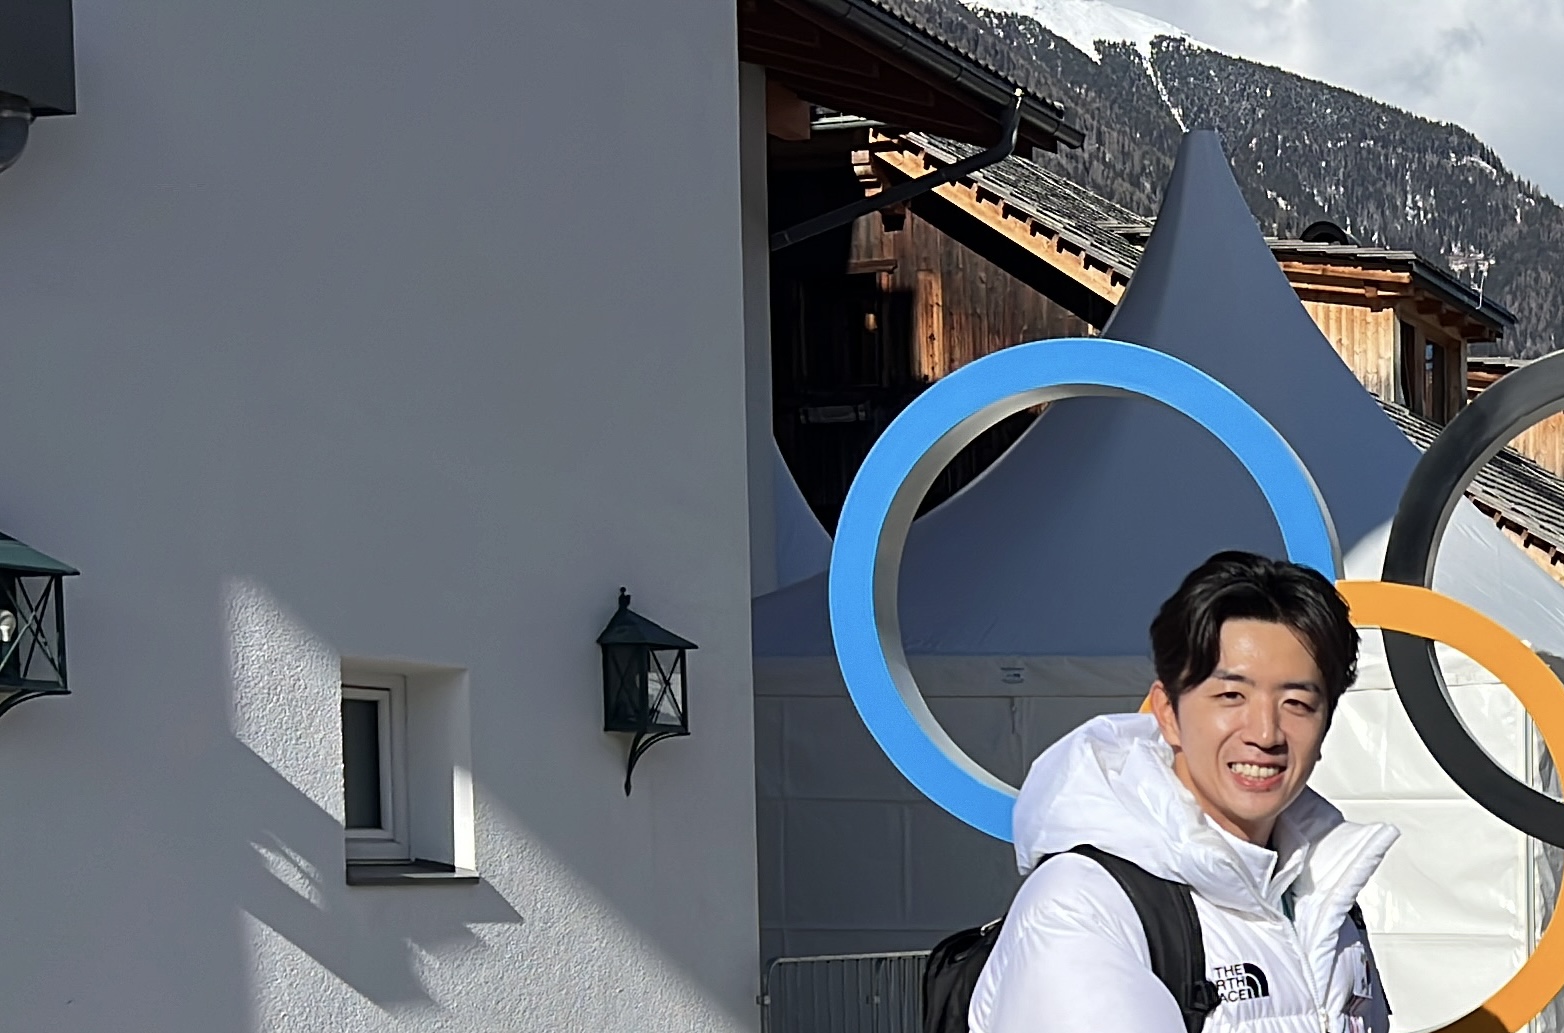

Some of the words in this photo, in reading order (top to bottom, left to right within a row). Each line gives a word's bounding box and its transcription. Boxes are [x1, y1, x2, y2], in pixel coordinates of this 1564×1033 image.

[1213, 964, 1242, 979] THE
[1216, 976, 1245, 991] RTH
[1220, 989, 1246, 1003] ACE
